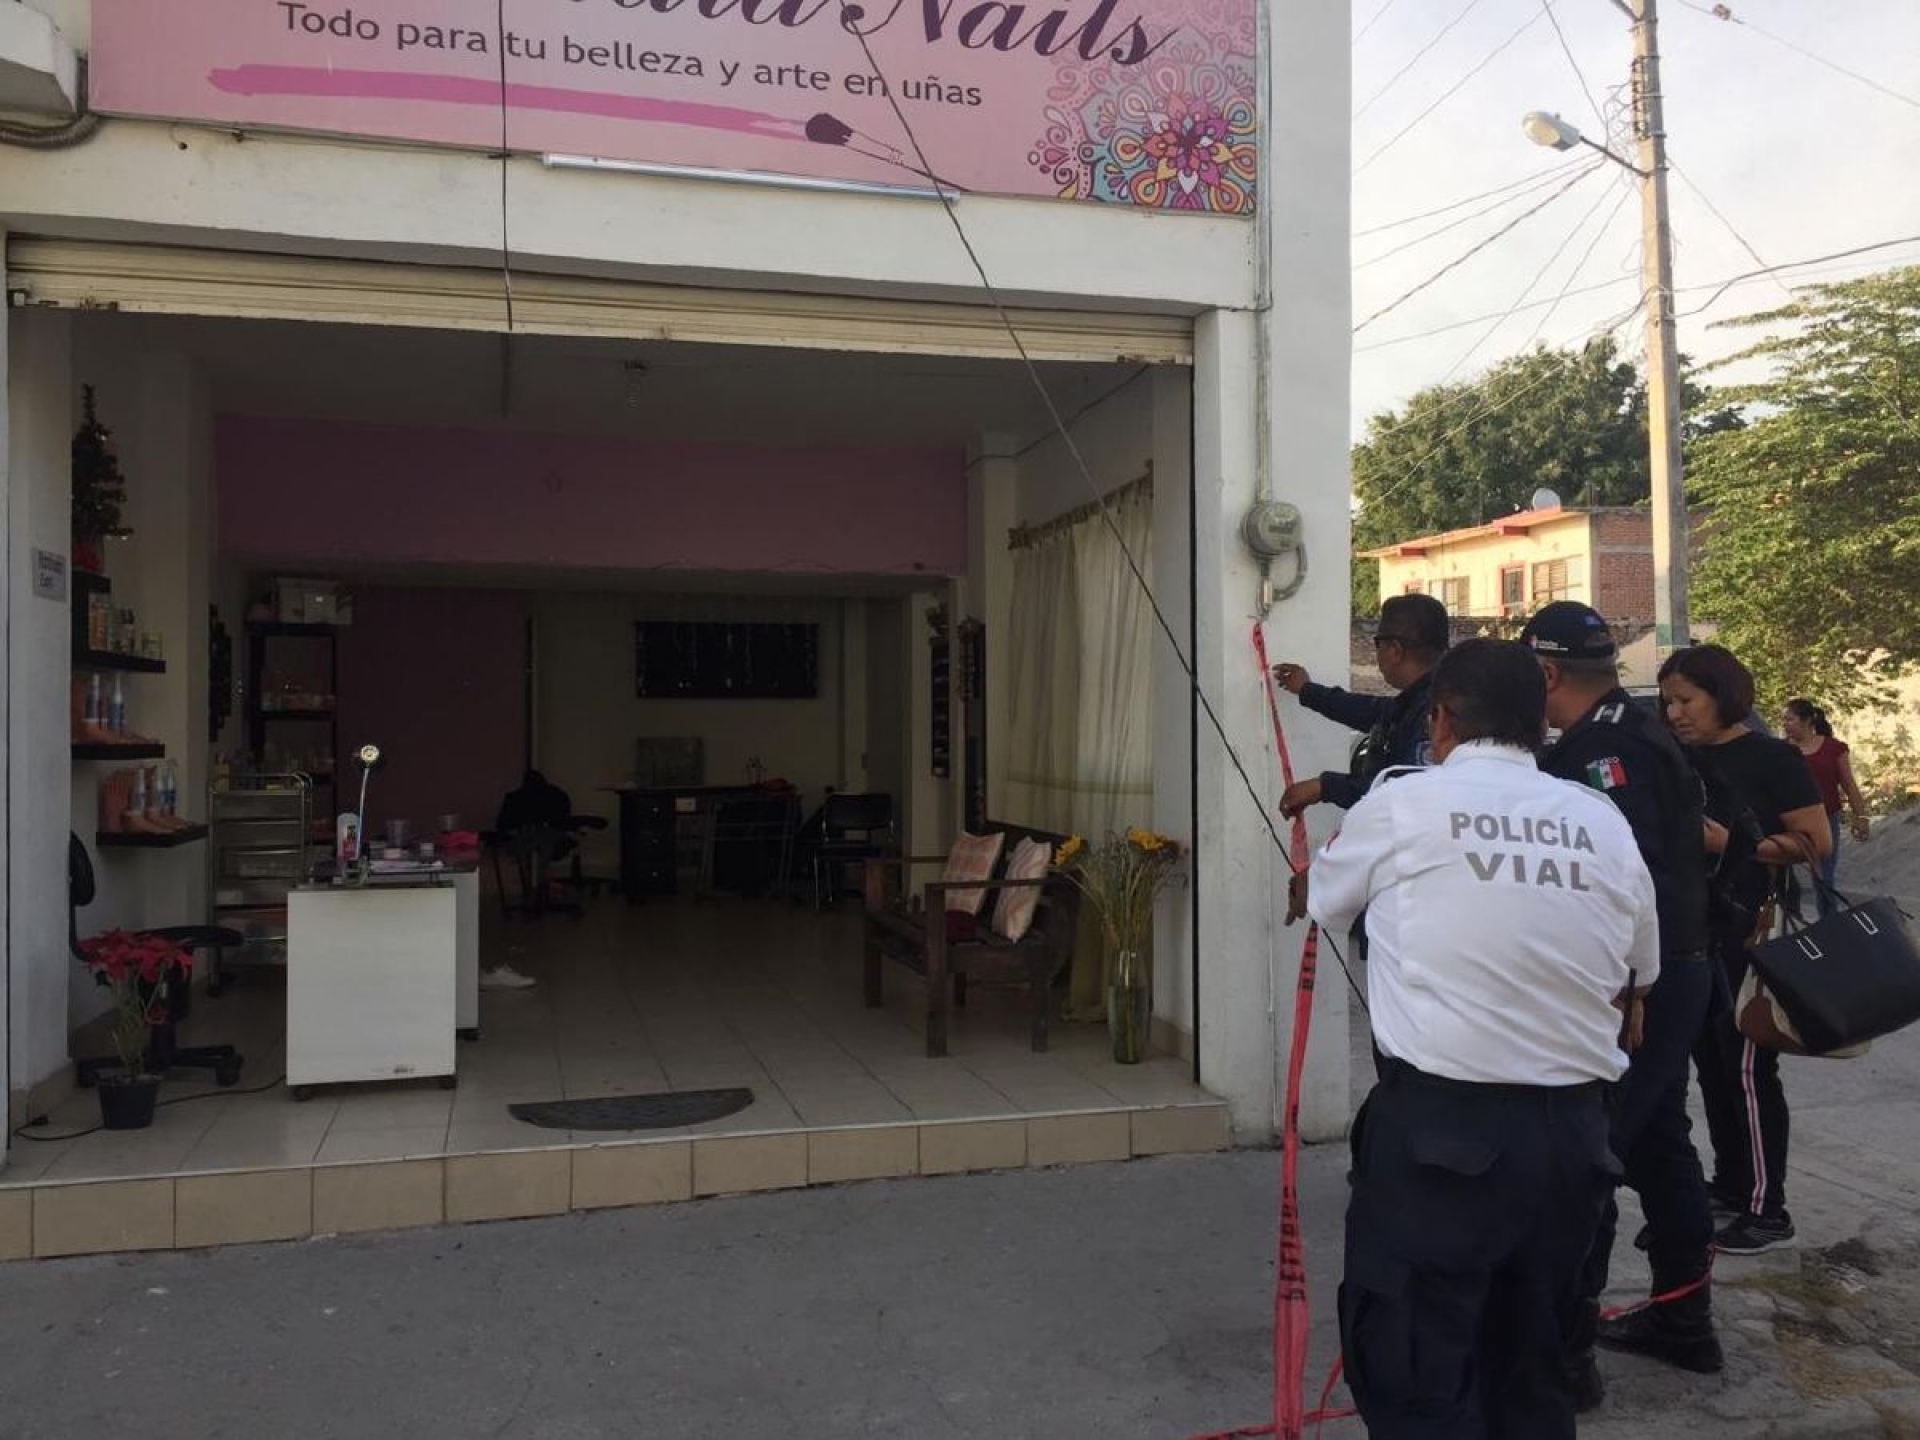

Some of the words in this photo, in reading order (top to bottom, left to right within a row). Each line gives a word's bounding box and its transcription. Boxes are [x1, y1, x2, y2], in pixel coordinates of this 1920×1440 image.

[277, 1, 380, 41] Todo
[396, 22, 487, 53] para
[505, 31, 546, 60] tu
[562, 35, 704, 78] belleza
[719, 58, 740, 87] y
[754, 63, 831, 91] arte
[844, 72, 888, 97] en
[902, 75, 982, 107] uñas
[1450, 812, 1596, 854] POLICÍA
[1464, 852, 1590, 892] VIAL
